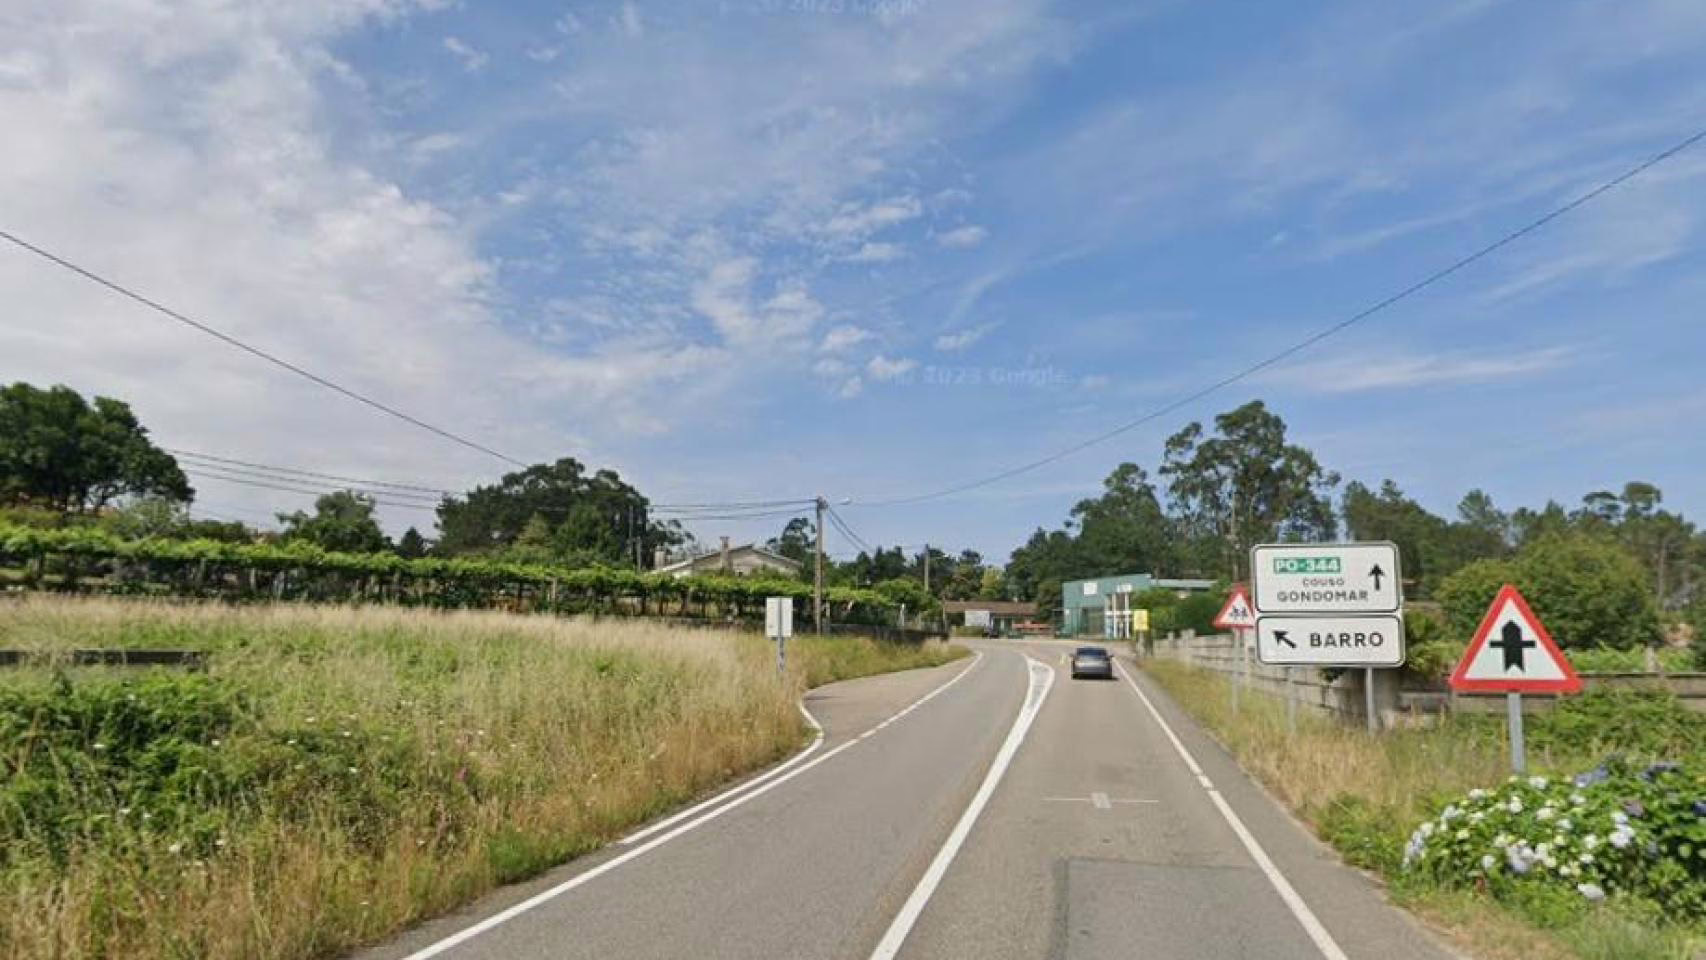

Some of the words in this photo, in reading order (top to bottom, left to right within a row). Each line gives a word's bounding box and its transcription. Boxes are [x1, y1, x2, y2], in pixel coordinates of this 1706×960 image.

[1275, 558, 1339, 572] PO-344
[1303, 577, 1344, 587] COUSO
[1277, 590, 1368, 602] GONDOMAR
[1310, 632, 1384, 648] BARRO
